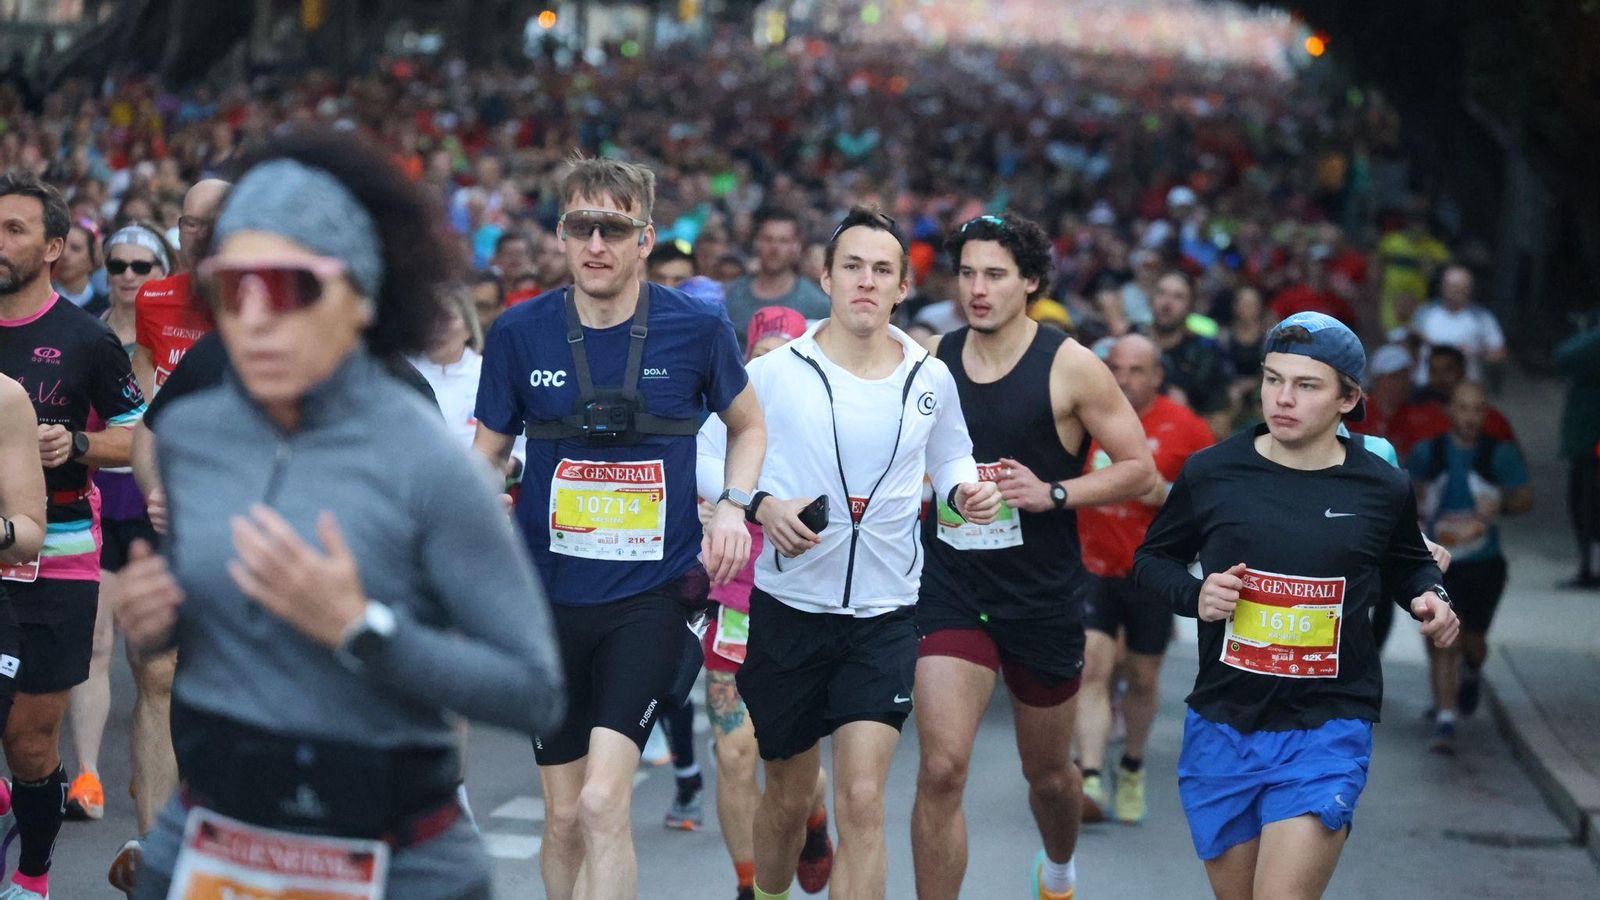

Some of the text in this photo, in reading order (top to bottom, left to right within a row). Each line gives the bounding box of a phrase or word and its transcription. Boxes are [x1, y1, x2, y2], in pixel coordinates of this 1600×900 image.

[530, 369, 567, 387] ORC
[583, 467, 656, 481] GENERALI
[576, 495, 640, 516] 10714
[1261, 579, 1336, 598] GENERALI
[1259, 609, 1311, 632] 1616
[1301, 654, 1321, 662] 42K
[639, 698, 658, 728] FUSION
